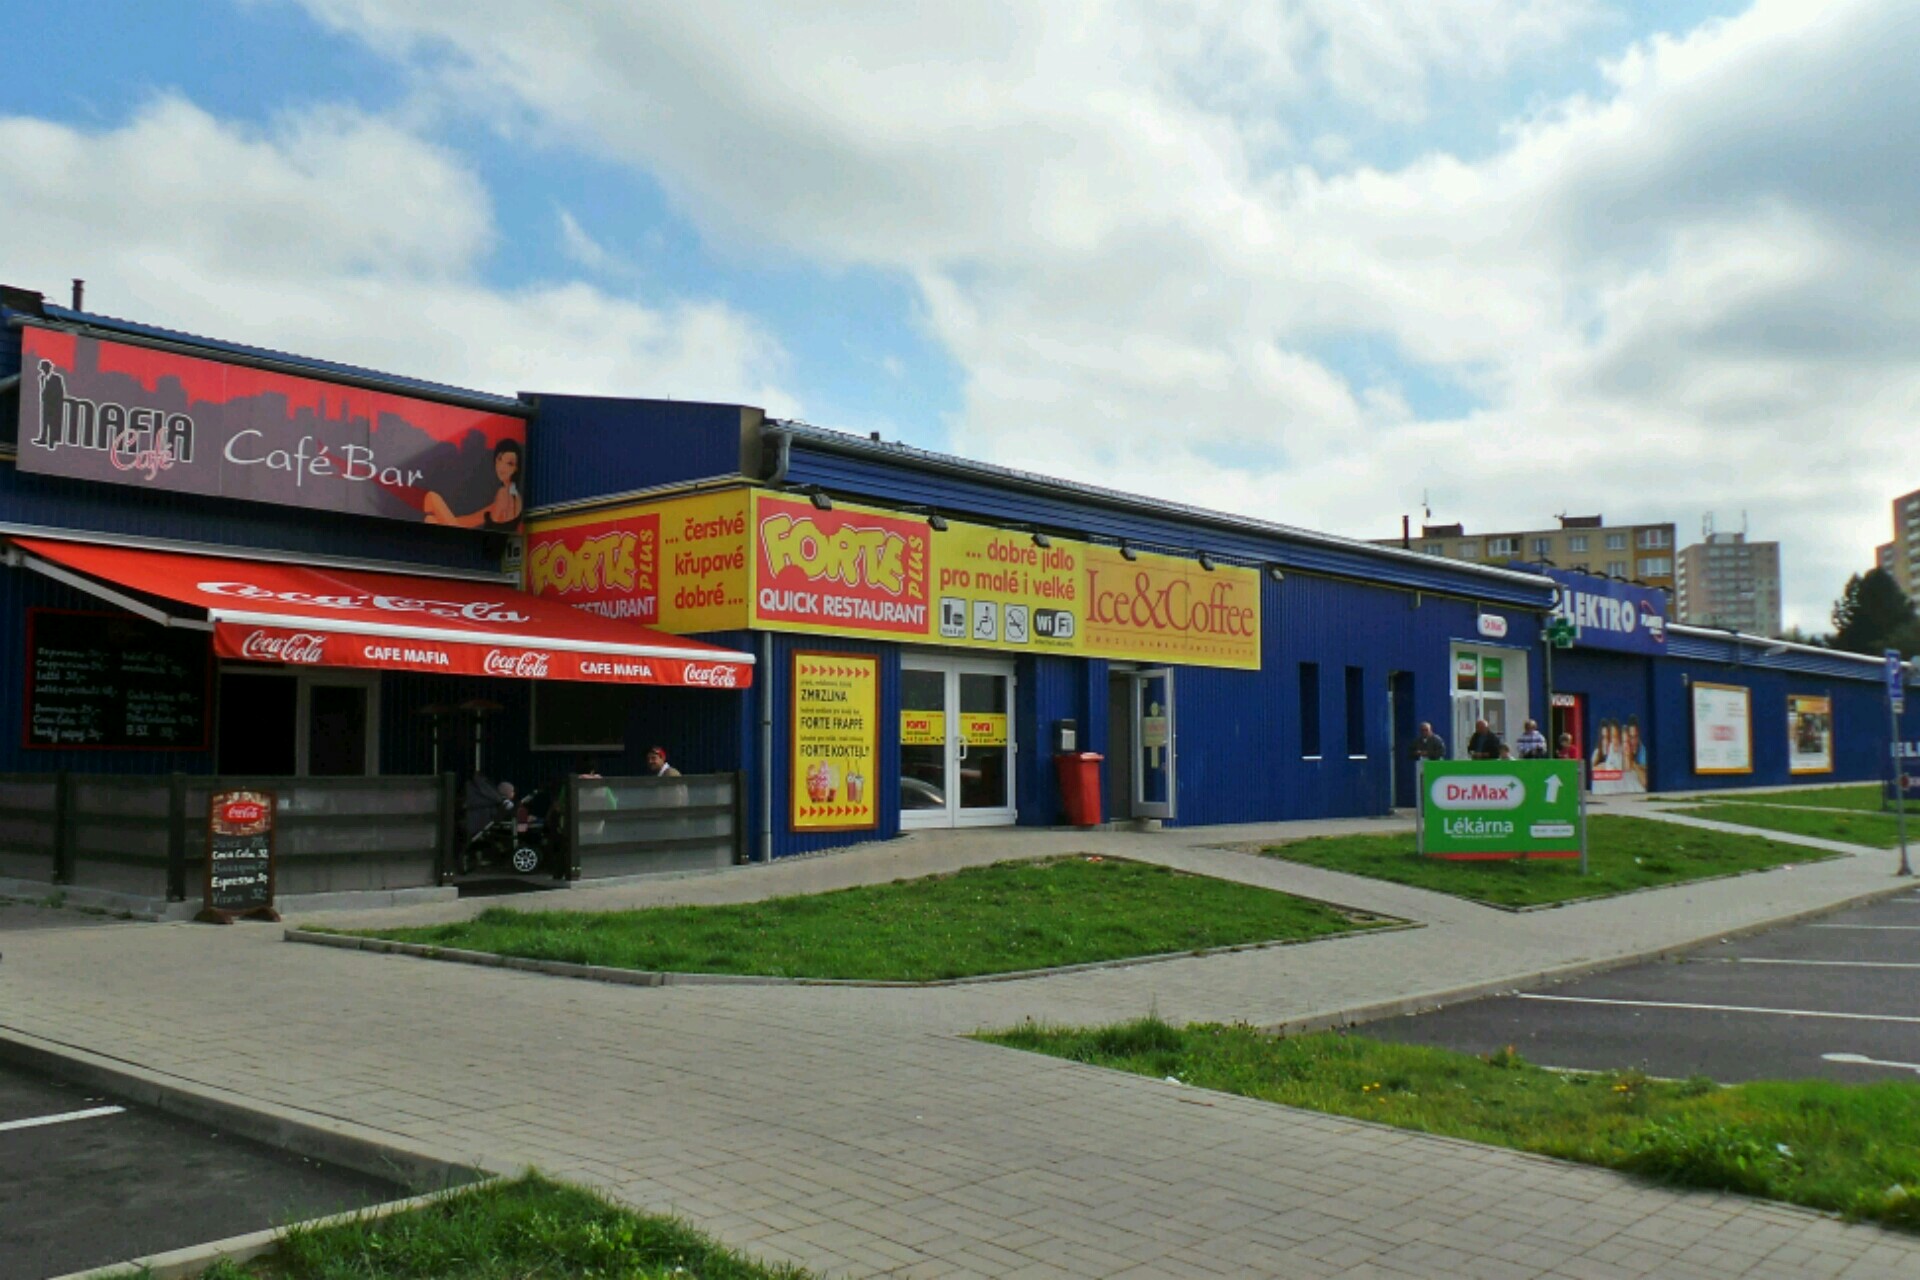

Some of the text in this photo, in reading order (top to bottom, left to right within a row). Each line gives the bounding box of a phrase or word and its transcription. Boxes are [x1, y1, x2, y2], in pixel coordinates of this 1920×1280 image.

[223, 429, 424, 488] Café Bar
[684, 510, 745, 542] čerstvé
[529, 530, 638, 597] FORTE
[675, 545, 744, 580] křupavé
[760, 513, 907, 597] FORTE
[987, 539, 1037, 565] dobré
[675, 583, 725, 610] dobré
[939, 567, 1076, 601] pro malé i velké
[759, 588, 927, 625] QUICK RESTAURANT
[242, 630, 327, 662] Coca-Cola
[364, 644, 449, 665] CAFE MAFIA
[483, 649, 550, 677] Coca-Cola
[580, 660, 652, 678] CAFE MAFIA
[801, 716, 831, 730] FORTE
[801, 744, 831, 757] FORTE
[1446, 783, 1508, 801] Dr.Max
[1443, 817, 1514, 835] Lékárna
